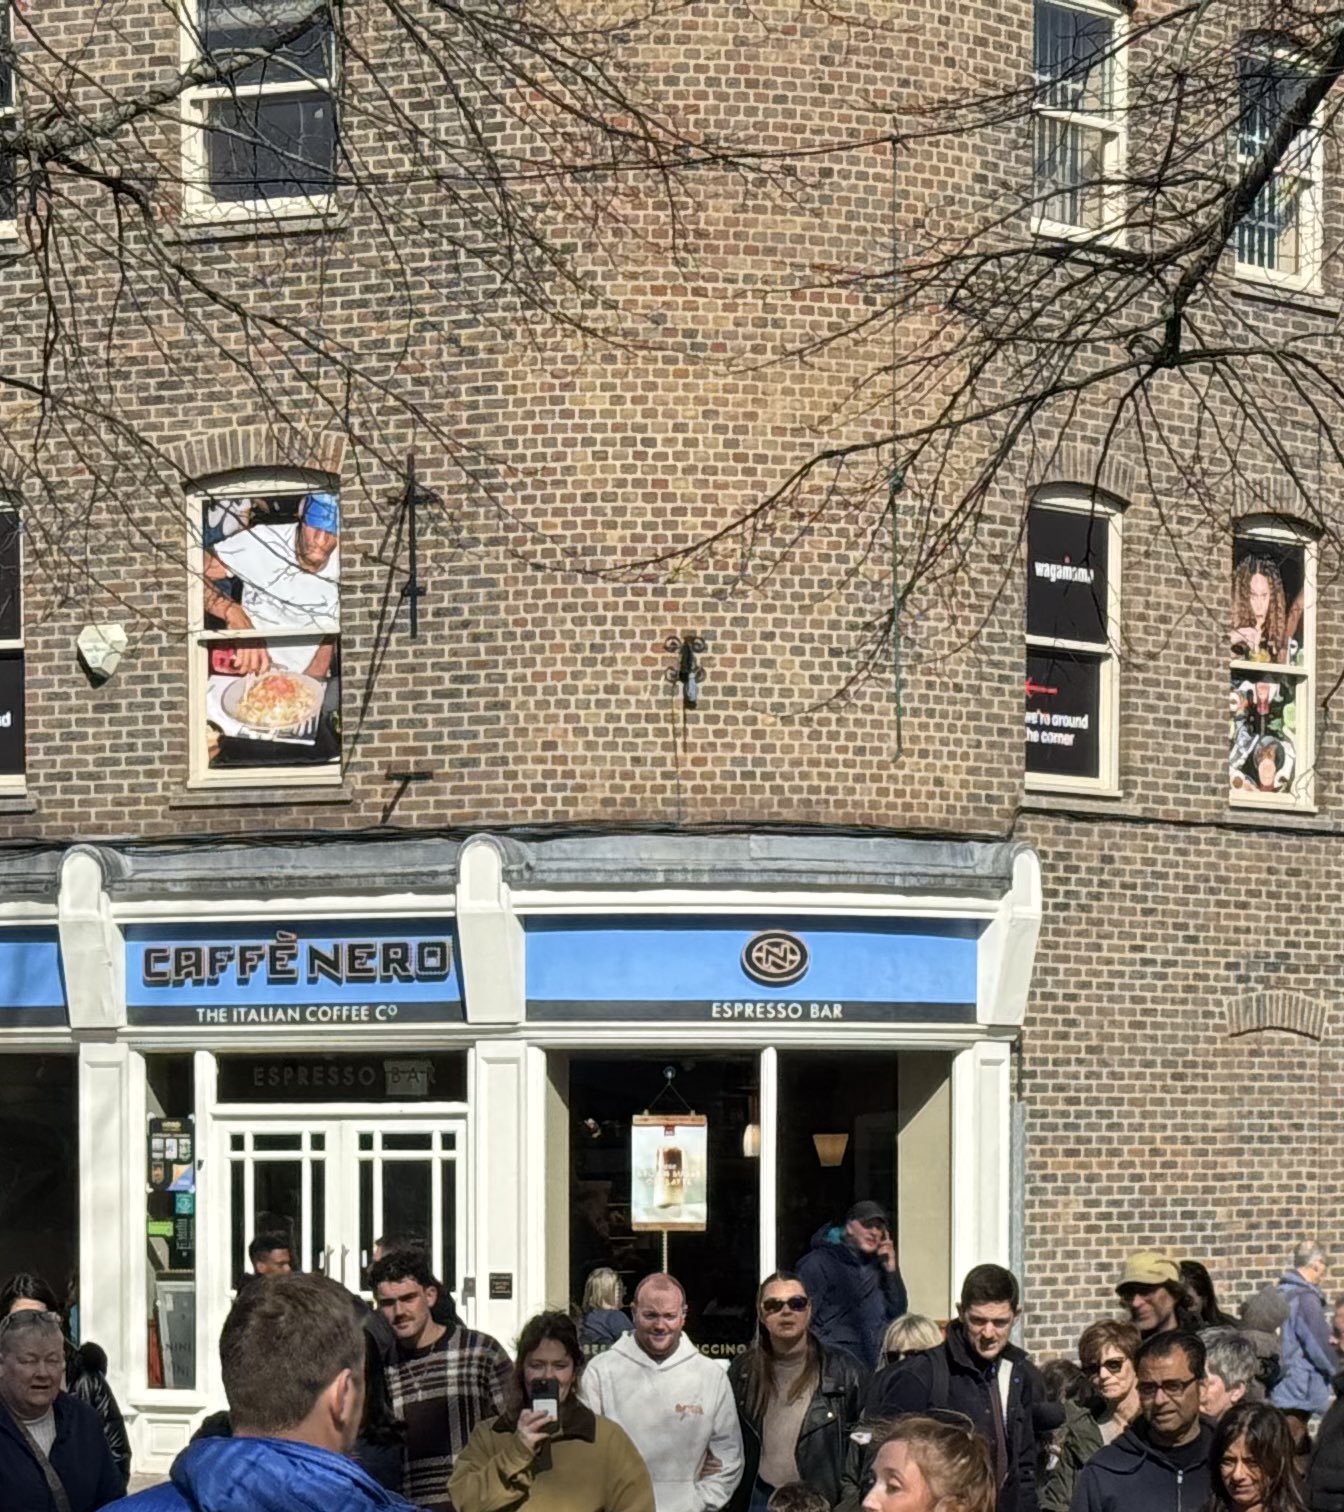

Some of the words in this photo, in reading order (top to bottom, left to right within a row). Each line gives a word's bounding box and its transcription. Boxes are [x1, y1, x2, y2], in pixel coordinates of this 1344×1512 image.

[1051, 713, 1089, 729] around
[1040, 731, 1076, 747] corner
[307, 941, 451, 986] NERO
[195, 1007, 229, 1024] THE
[232, 1007, 301, 1024] ITALIAN
[305, 1006, 370, 1023] COFFEE
[711, 1002, 803, 1019] ESPRESSO
[809, 1002, 844, 1019] BAR
[252, 1065, 376, 1088] ESPRESSO
